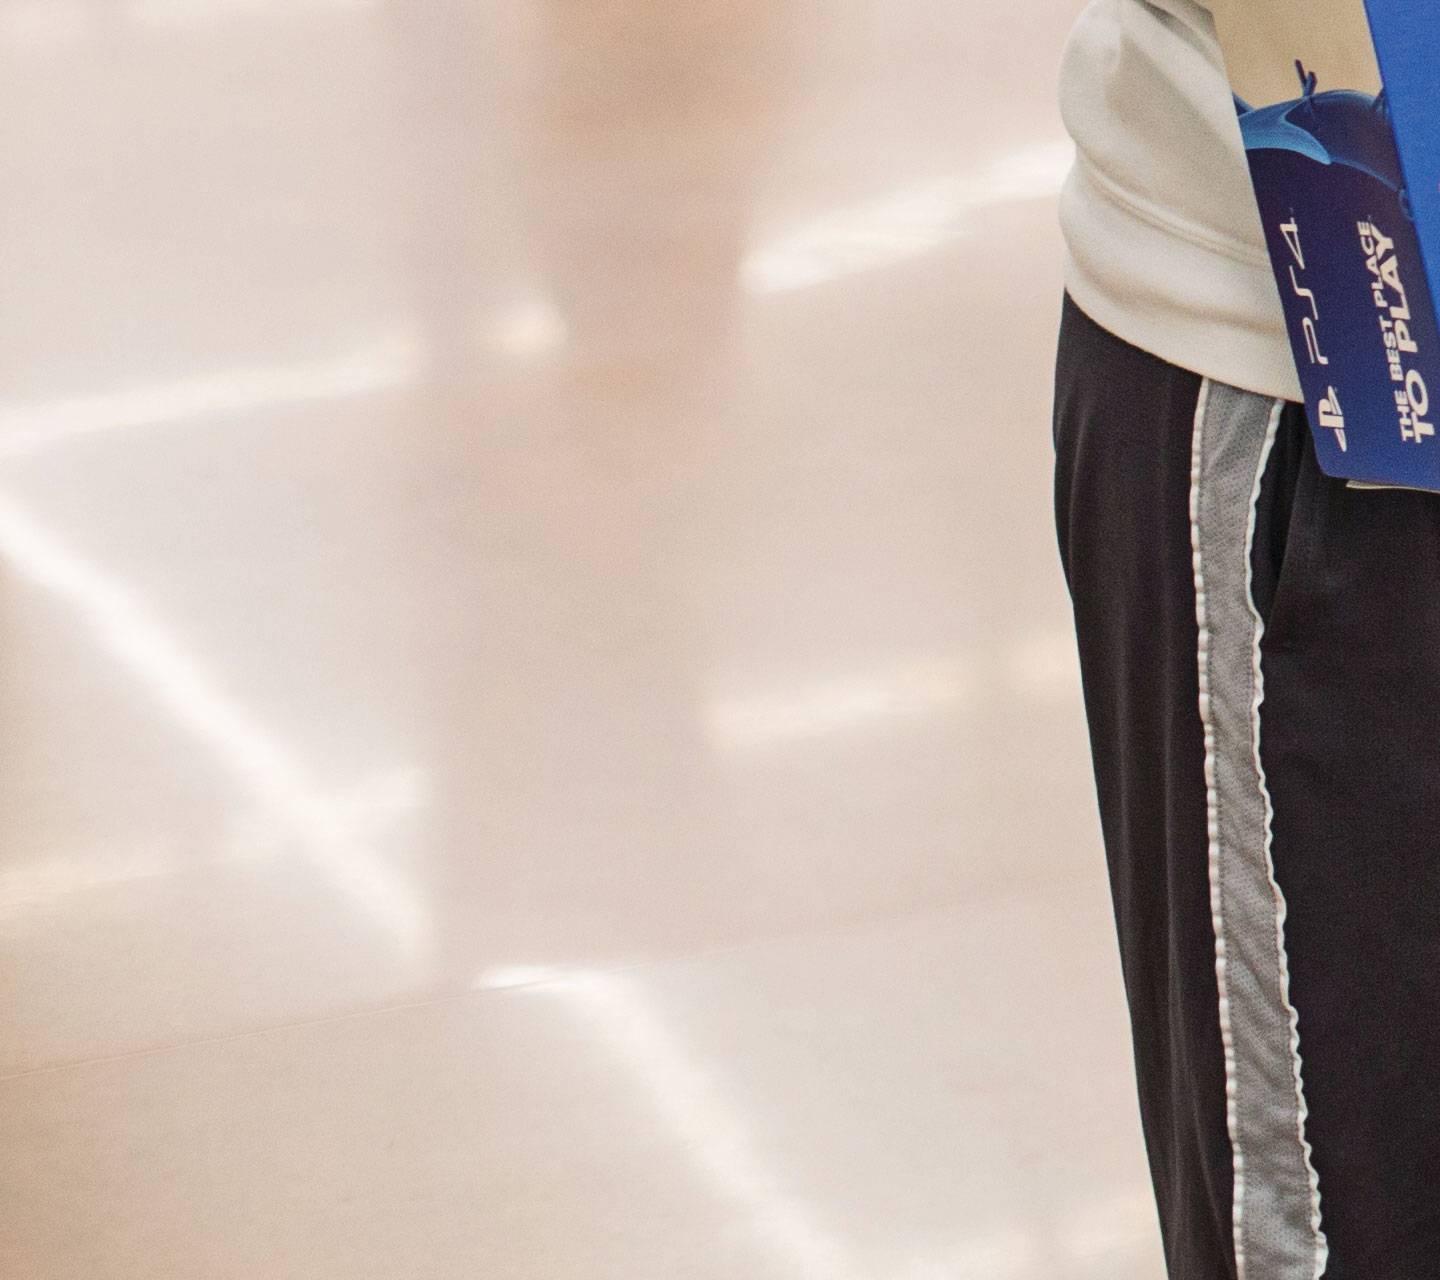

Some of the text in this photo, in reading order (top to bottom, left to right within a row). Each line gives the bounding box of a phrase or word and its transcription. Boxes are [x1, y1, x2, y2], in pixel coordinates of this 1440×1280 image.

[1280, 217, 1329, 365] PS4
[1356, 220, 1414, 442] THE BEST PLACE
[1370, 223, 1436, 444] TO PLAY
